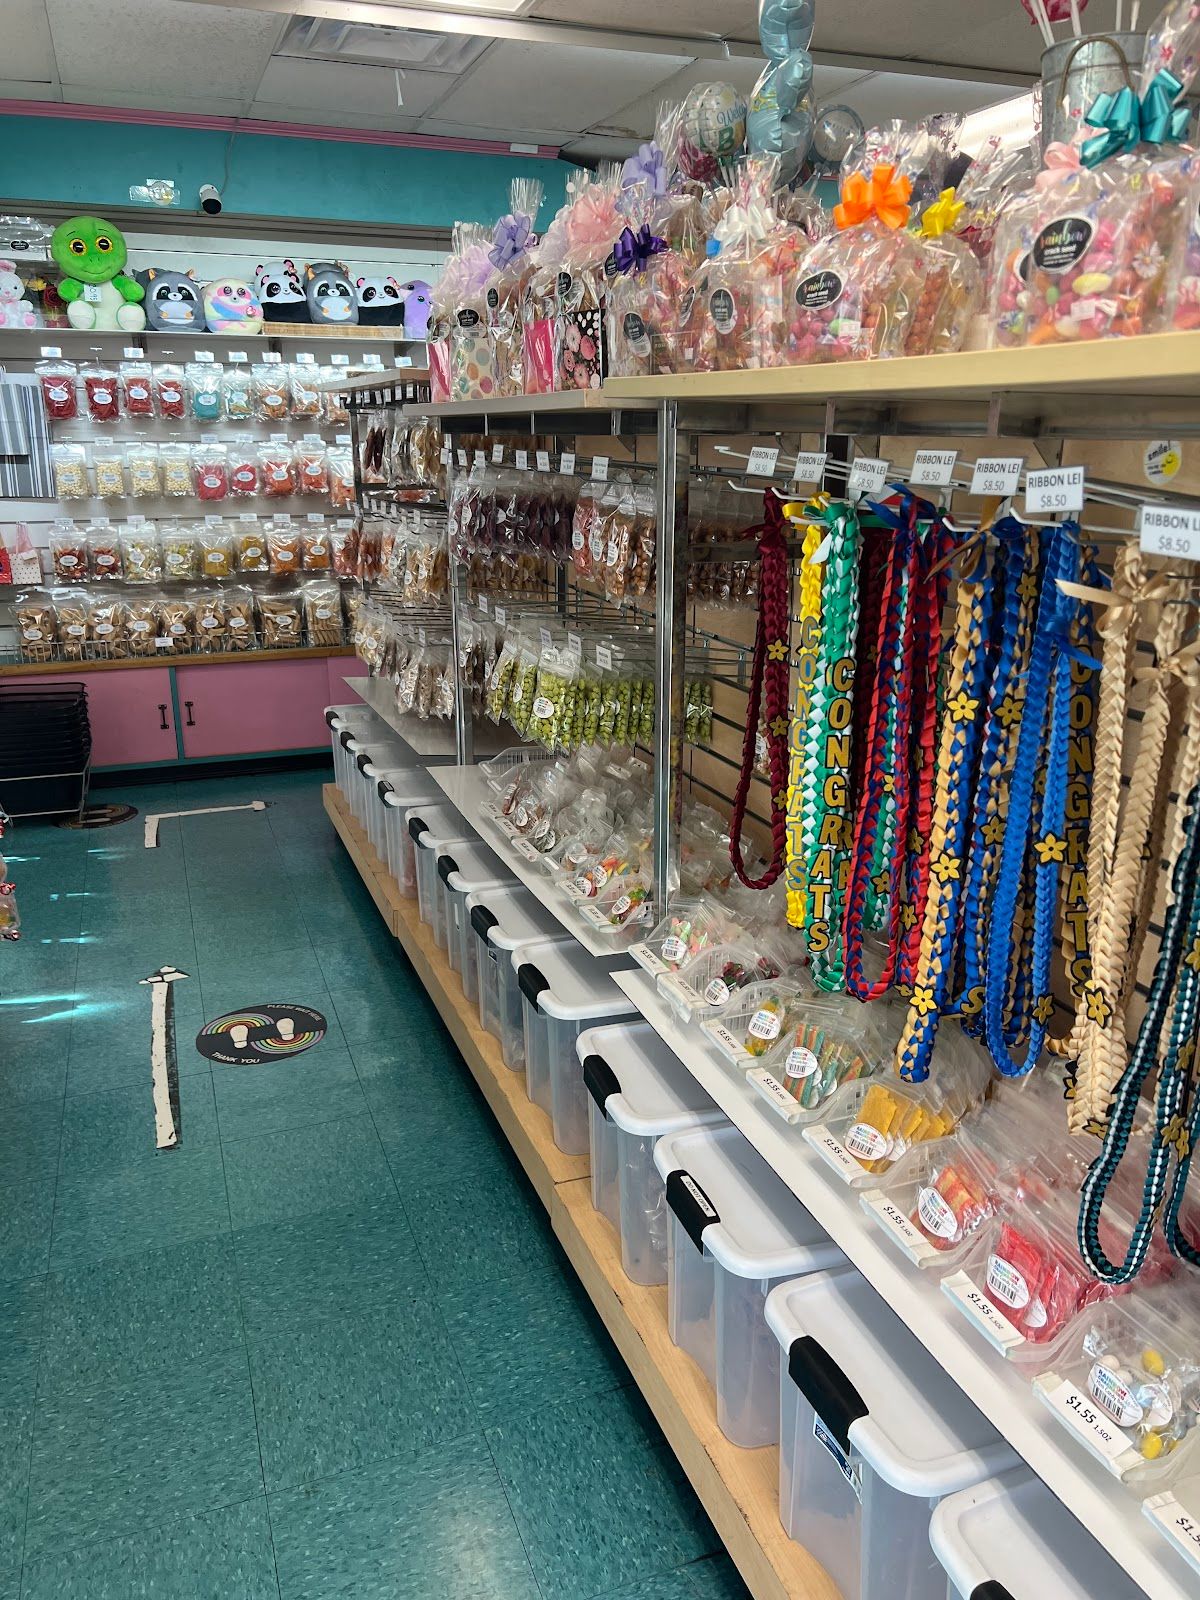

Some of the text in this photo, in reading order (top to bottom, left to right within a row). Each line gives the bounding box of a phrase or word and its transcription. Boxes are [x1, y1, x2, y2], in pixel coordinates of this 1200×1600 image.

[752, 450, 769, 459] RIBBON
[799, 456, 825, 466] RIBBON LEI
[916, 454, 954, 465] RIBBON LEI
[854, 461, 886, 474] RIBBON LEI
[976, 463, 1019, 473] RIBBON LEI
[921, 472, 940, 481] $8.50
[1028, 473, 1081, 488] RIBBON LEI
[982, 480, 1004, 491] $8.50
[1040, 495, 1067, 507] $8.50
[1144, 512, 1189, 529] RIBBON
[1158, 536, 1190, 552] $8.50
[807, 657, 856, 952] CONGRATS
[212, 1052, 238, 1063] THANK
[824, 1138, 842, 1154] $1.55
[686, 1181, 710, 1211] DO NOT OPEN
[883, 1206, 904, 1224] $1.55
[967, 1293, 992, 1314] $1.55
[1066, 1395, 1097, 1424] $1.55
[1176, 1518, 1200, 1546] $1.5
